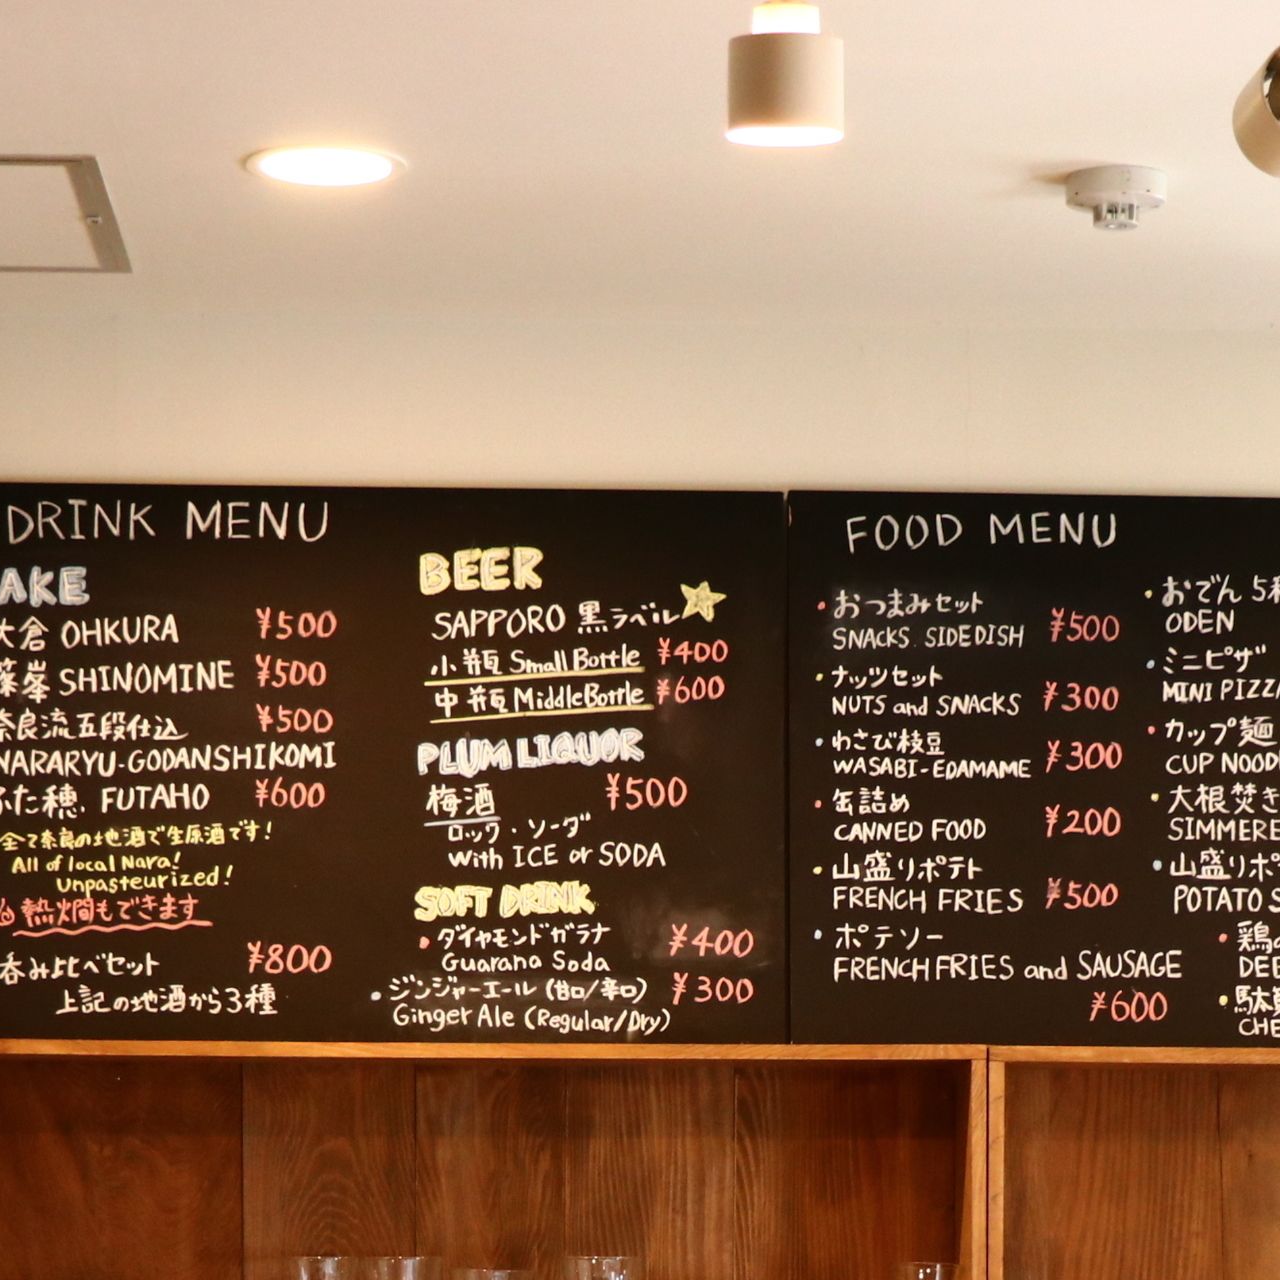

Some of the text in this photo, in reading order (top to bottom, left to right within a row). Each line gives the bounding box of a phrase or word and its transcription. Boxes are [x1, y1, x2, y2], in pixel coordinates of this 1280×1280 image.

[7, 498, 328, 544] DRINK MENU
[846, 511, 1116, 553] FOOD MENU
[418, 546, 544, 596] BEER
[60, 613, 180, 650] OHKURA
[255, 606, 338, 641] ¥500
[431, 603, 567, 641] SAPPORO
[833, 588, 1120, 642] おつまみセット ¥500
[1165, 608, 1235, 635] ODEN
[430, 647, 503, 676] 小瓶
[657, 636, 729, 666] ¥400
[1162, 643, 1267, 675] ミニピザ
[58, 659, 235, 697] SHINOMINE
[254, 653, 328, 689] ¥500
[831, 664, 943, 690] ナッツセット
[1162, 680, 1213, 704] MINI
[434, 684, 509, 718] 中瓶
[655, 675, 726, 706] ¥600
[831, 694, 888, 716] NUTS
[892, 695, 929, 717] and
[1043, 680, 1120, 712] ¥300
[255, 703, 334, 734] ¥500
[416, 727, 646, 779] PLUM LIQUOR
[831, 727, 946, 756] わさび枝豆
[1045, 739, 1123, 773] ¥300
[1165, 751, 1215, 775] CUP
[101, 782, 211, 814] FUTAHO
[254, 775, 326, 810] ¥600
[425, 772, 688, 817] 梅酒 ¥500
[832, 785, 911, 817] 缶詰め
[833, 803, 1122, 845] CANNED FOOD ¥200
[11, 856, 39, 875] All
[45, 853, 64, 872] of
[68, 853, 116, 873] local
[512, 843, 559, 868] ICE
[568, 845, 594, 865] or
[598, 840, 667, 868] SODA
[832, 849, 983, 884] 山盛りポテト
[413, 879, 597, 923] SOFT DRINK
[832, 877, 1119, 915] FRENCH FRIES ¥500
[1173, 884, 1263, 915] POTATO
[246, 940, 333, 975] ¥800
[667, 922, 755, 959] ¥400
[441, 949, 611, 973] Guarana Soda
[833, 949, 1183, 983] FRENCH FRIES and SAUSAGE
[671, 971, 755, 1006] ¥300
[1089, 989, 1168, 1023] ¥600
[392, 1002, 474, 1033] Ginger
[476, 1002, 516, 1029] Ale
